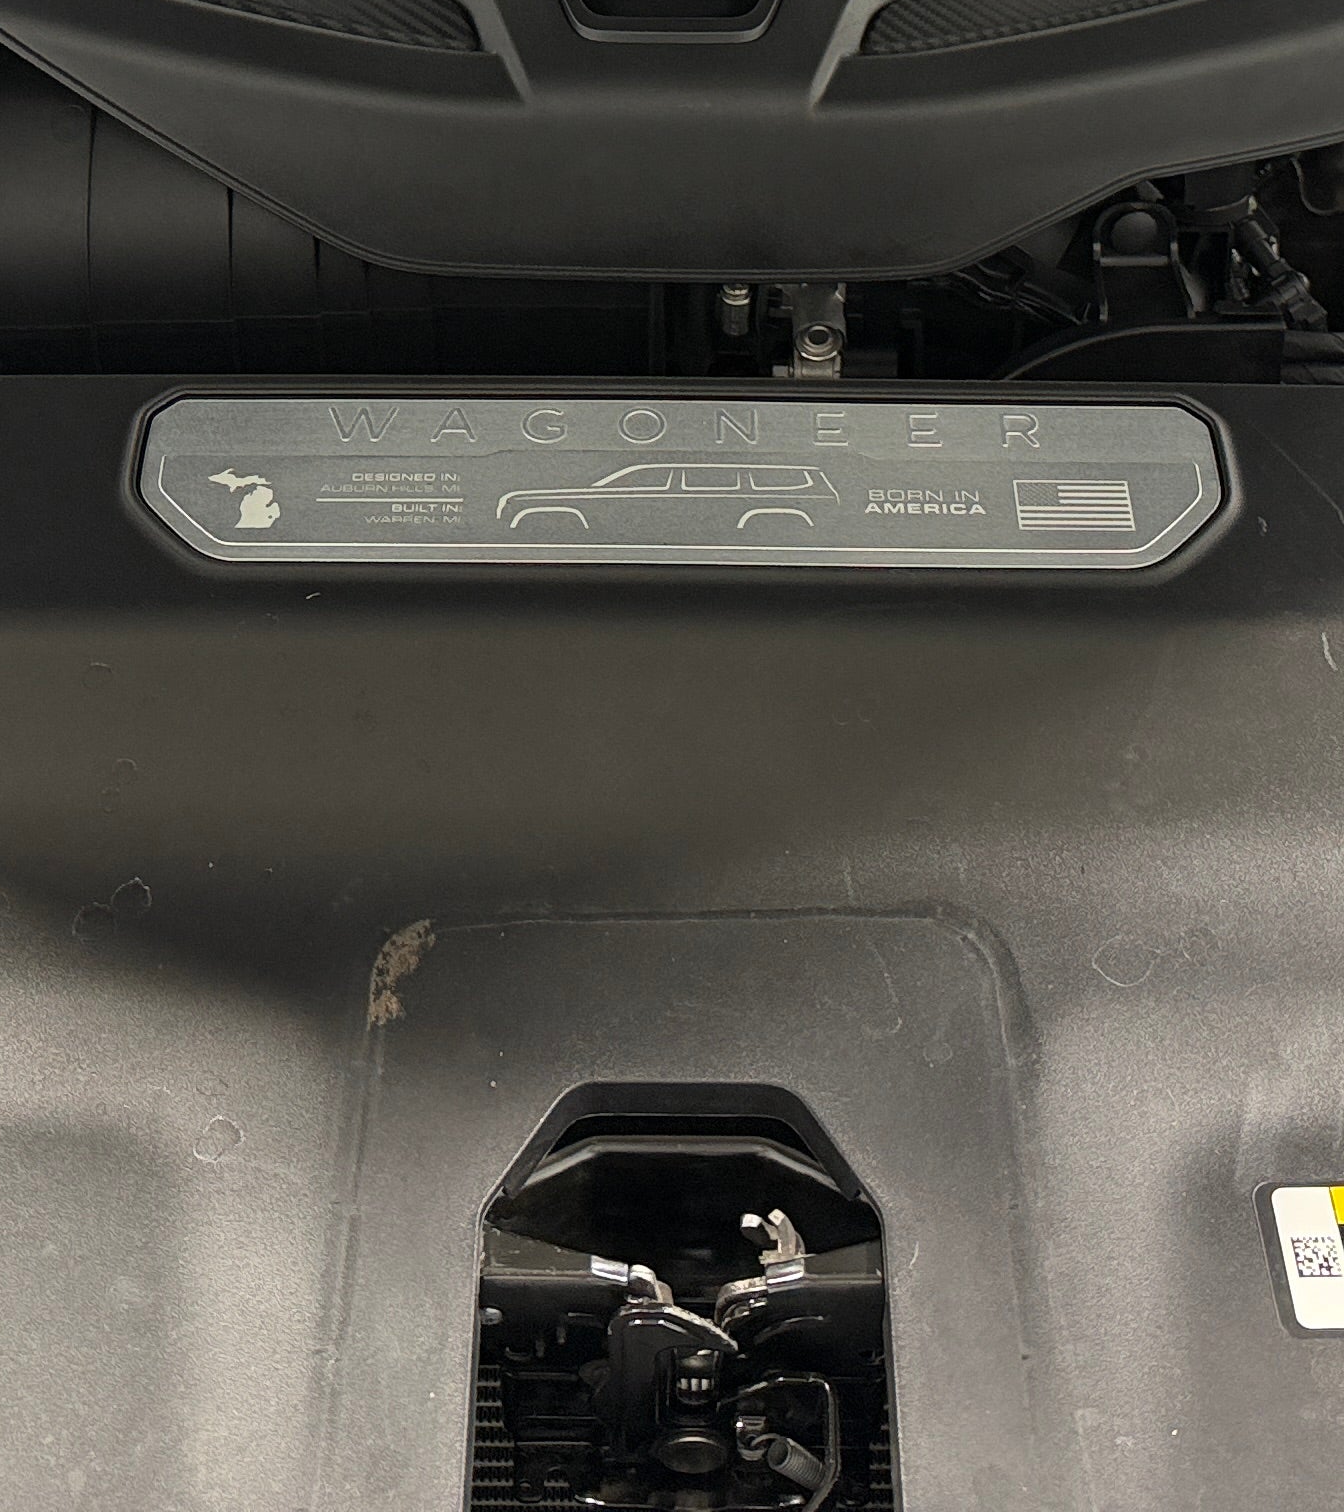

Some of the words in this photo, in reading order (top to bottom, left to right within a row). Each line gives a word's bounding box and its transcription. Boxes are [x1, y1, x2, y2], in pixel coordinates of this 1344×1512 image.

[328, 406, 1040, 449] WAGONEER
[351, 472, 436, 482] DESIGNED
[320, 483, 388, 494] AUBURN
[441, 484, 460, 493] MI
[867, 489, 943, 503] BORN
[954, 490, 980, 503] IN
[391, 503, 438, 513] BUILT
[864, 502, 987, 516] AMERICA
[442, 515, 462, 524] MI
